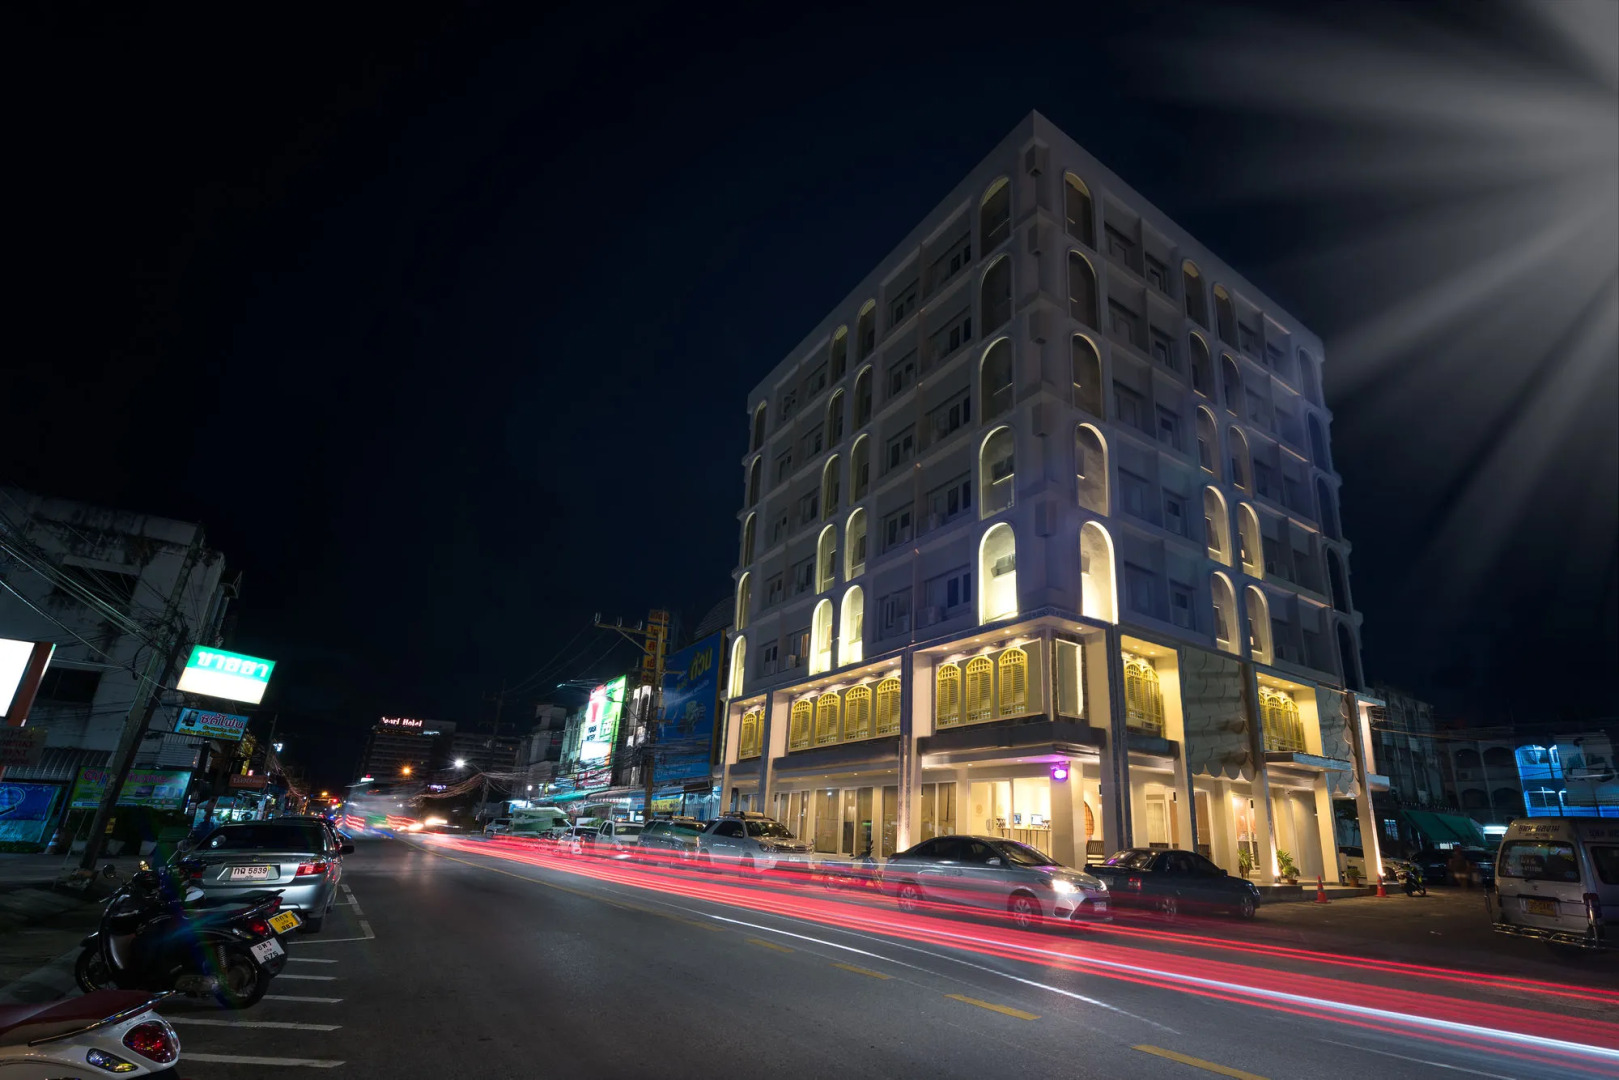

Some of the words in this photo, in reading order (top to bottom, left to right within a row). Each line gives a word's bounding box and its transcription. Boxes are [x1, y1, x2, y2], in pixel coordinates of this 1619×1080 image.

[197, 651, 269, 677] ขายยา
[402, 718, 423, 727] Hotel
[248, 867, 268, 875] 5839
